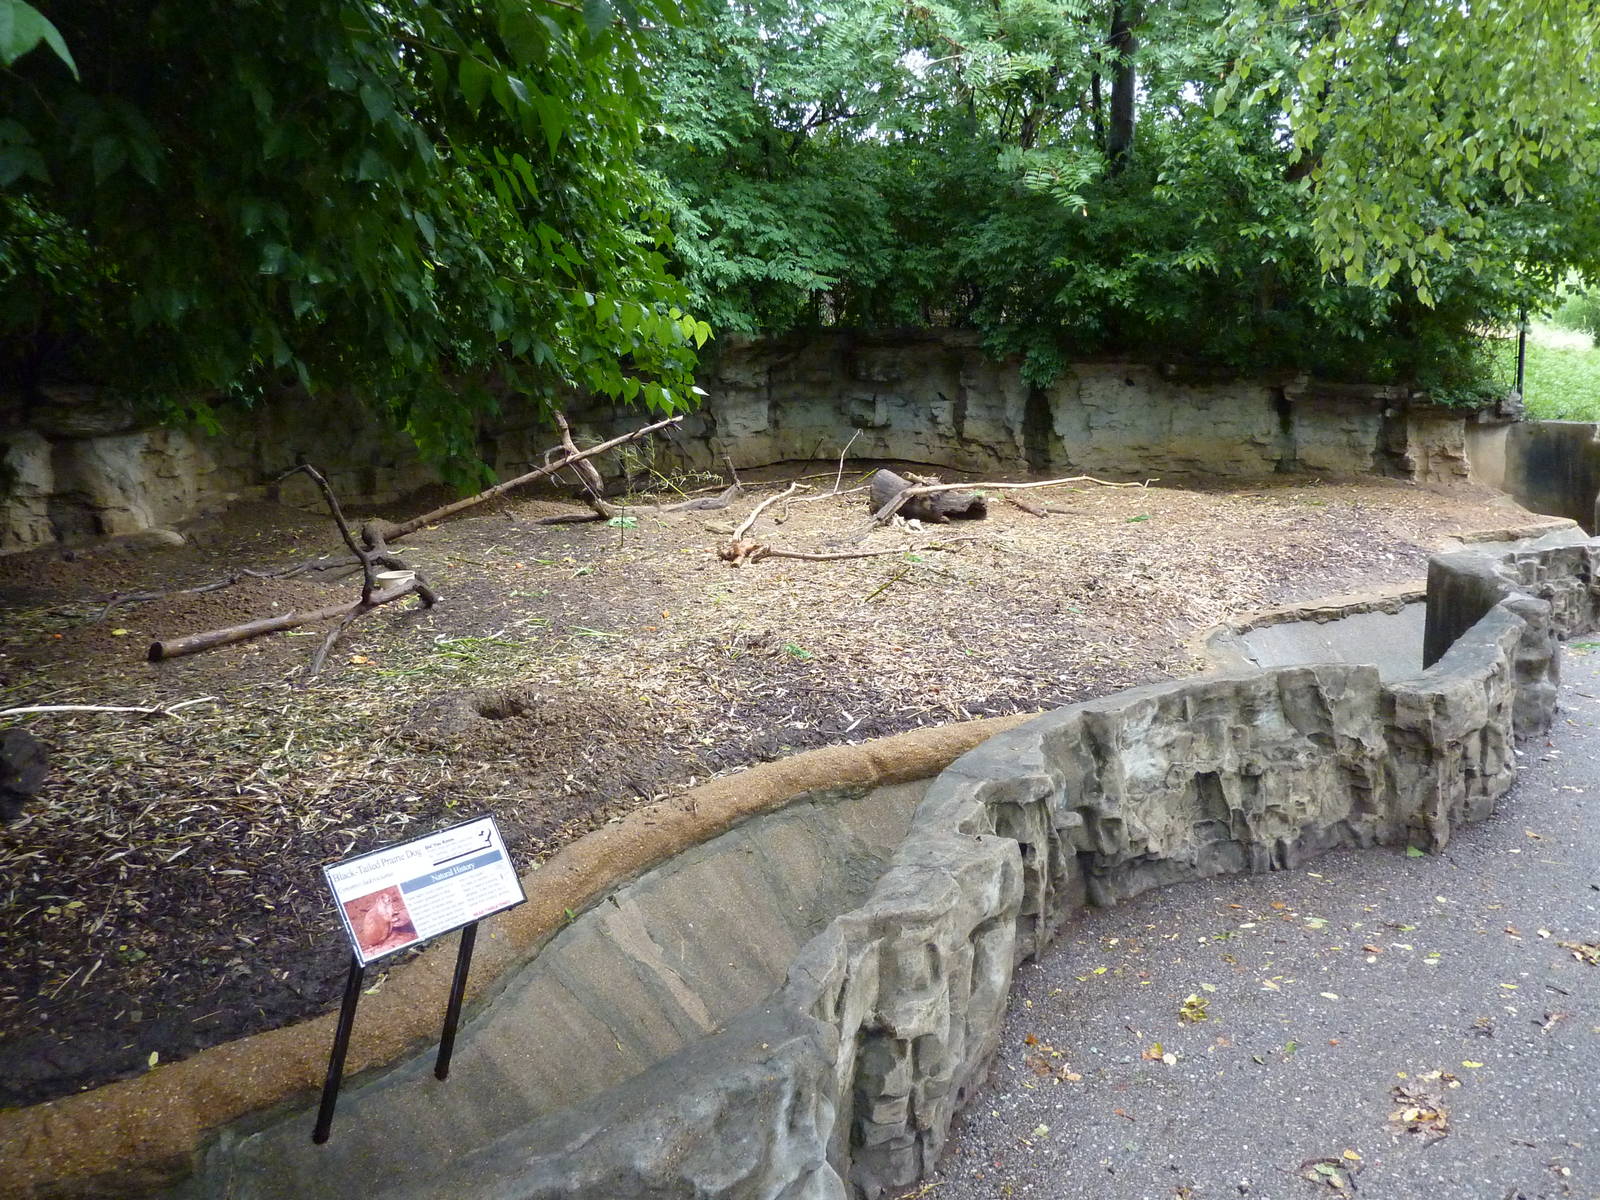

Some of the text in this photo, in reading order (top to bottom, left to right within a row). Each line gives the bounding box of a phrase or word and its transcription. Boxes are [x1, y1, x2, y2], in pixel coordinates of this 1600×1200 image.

[405, 848, 423, 860] Dog
[430, 861, 475, 882] Natural History
